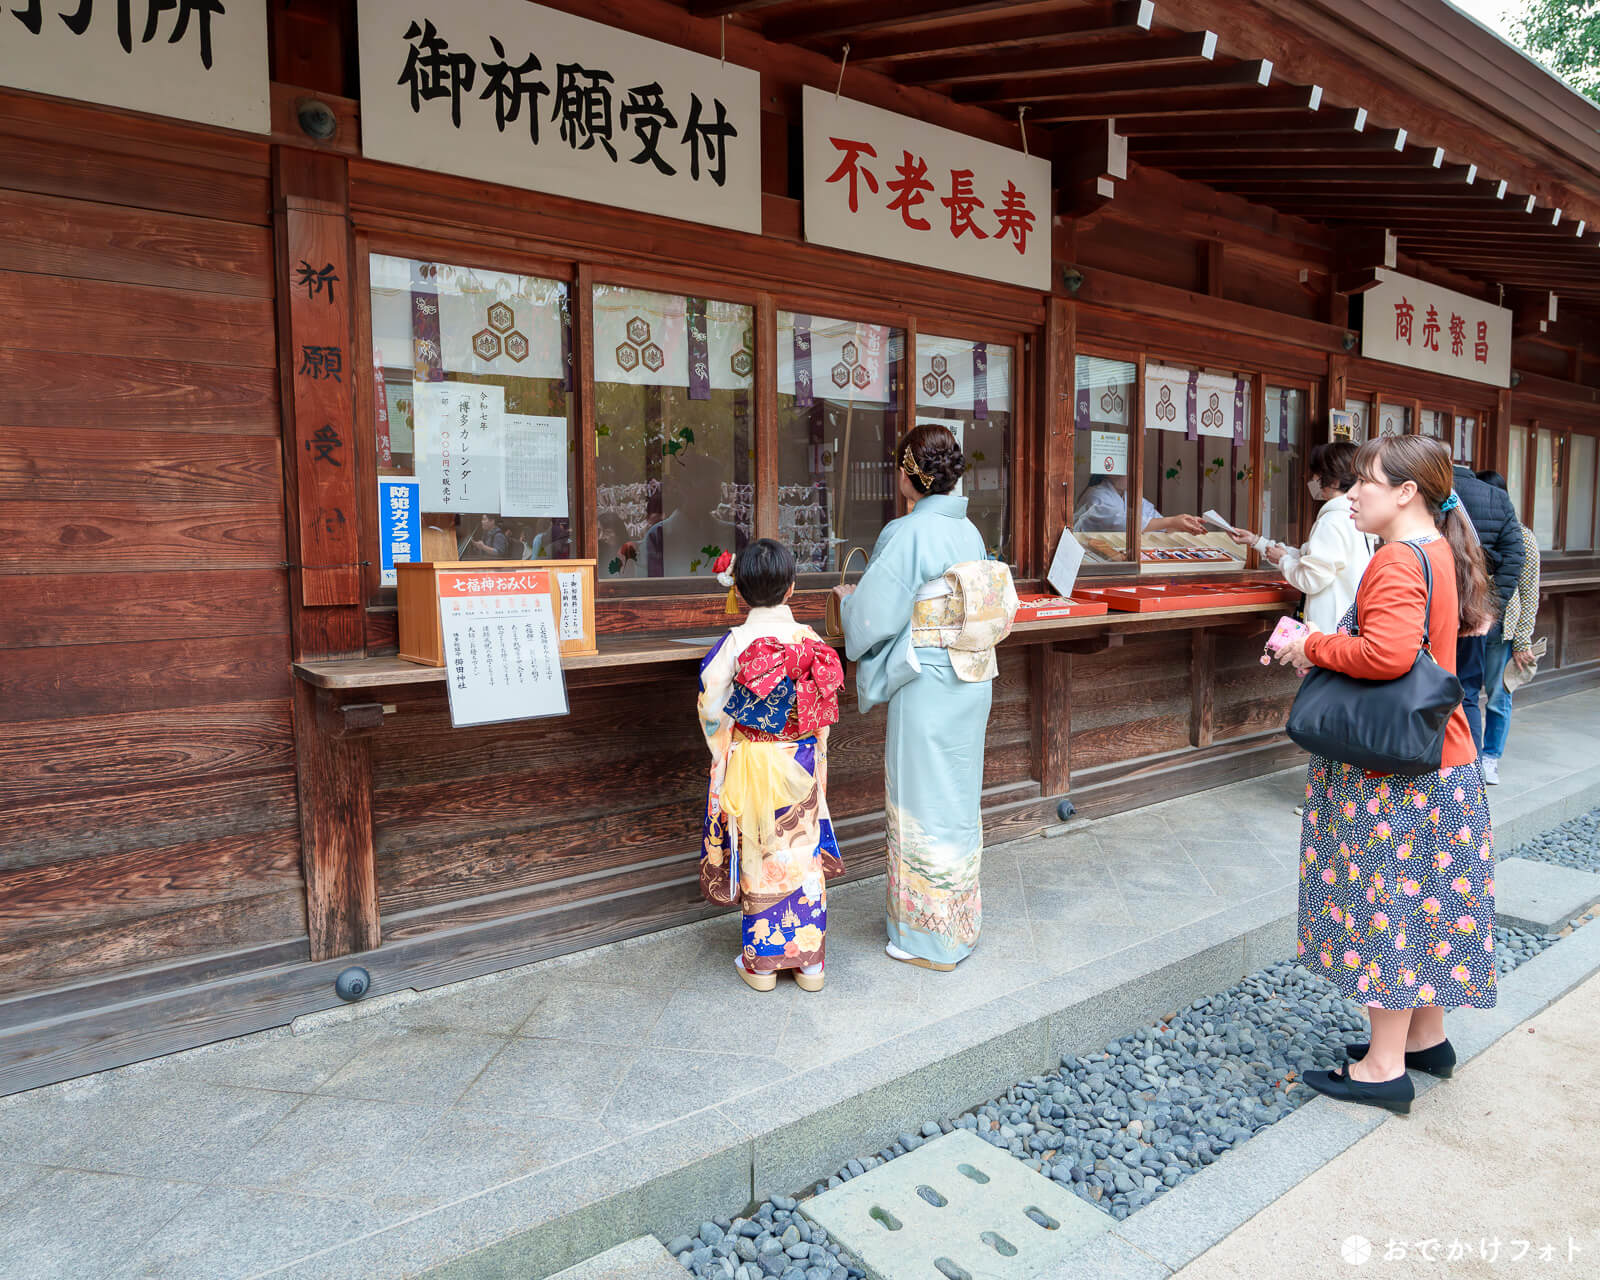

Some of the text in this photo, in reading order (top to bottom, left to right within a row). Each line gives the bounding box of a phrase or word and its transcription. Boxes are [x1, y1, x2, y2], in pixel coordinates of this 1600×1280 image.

[398, 18, 738, 187] 御祈願受付
[825, 136, 1036, 255] 不老長寿
[1394, 296, 1489, 365] 商売繁昌
[479, 392, 489, 431] 令和七年
[452, 575, 539, 592] 七福神おみくじ
